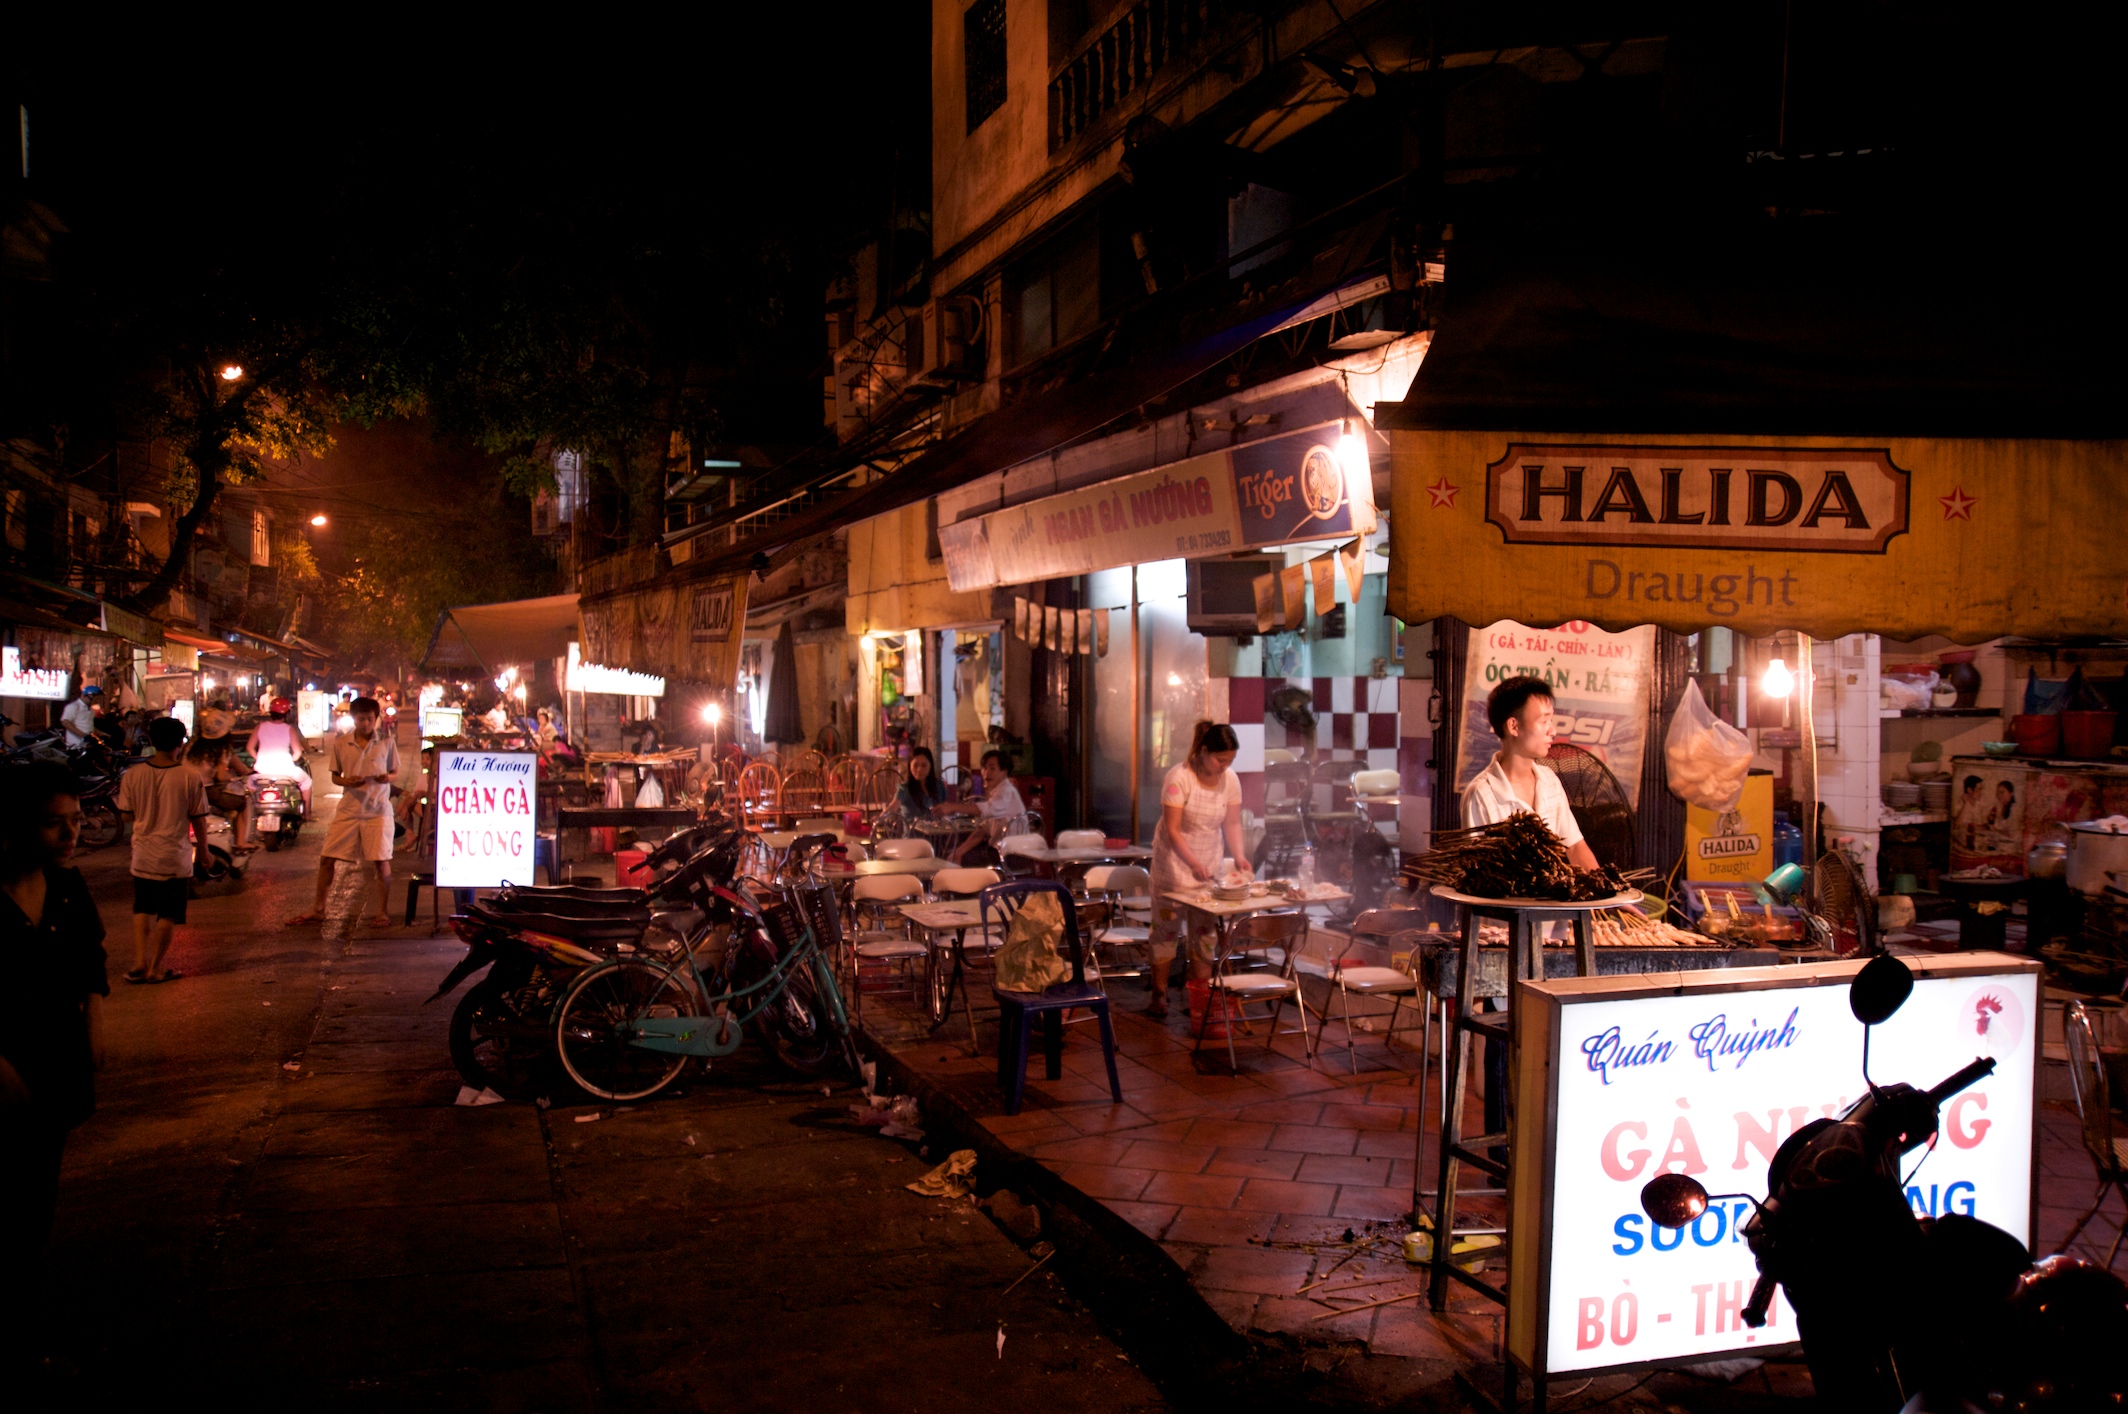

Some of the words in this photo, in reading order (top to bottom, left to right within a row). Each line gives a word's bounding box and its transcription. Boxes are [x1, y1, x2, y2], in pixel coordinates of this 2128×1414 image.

[1043, 504, 1097, 546] NGAN
[1098, 489, 1130, 534] GÀ
[1130, 473, 1214, 529] NƯỚNG
[1239, 469, 1294, 520] Tiger
[1519, 464, 1871, 530] HALIDA
[1584, 559, 1798, 618] Draught
[1497, 633, 1516, 649] GÀ
[1526, 635, 1548, 652] TÁI
[1557, 638, 1589, 656] CHÍN
[446, 756, 477, 772] Mai
[441, 779, 497, 815] CHÂN
[503, 779, 530, 815] GÀ
[1703, 838, 1755, 855] HALIDA
[1708, 860, 1750, 876] Draught
[1580, 1025, 1678, 1086] Quán
[1689, 1005, 1802, 1072] Quỳnh
[1600, 1097, 1709, 1183] GÀ
[1576, 1279, 1639, 1351] BÒ
